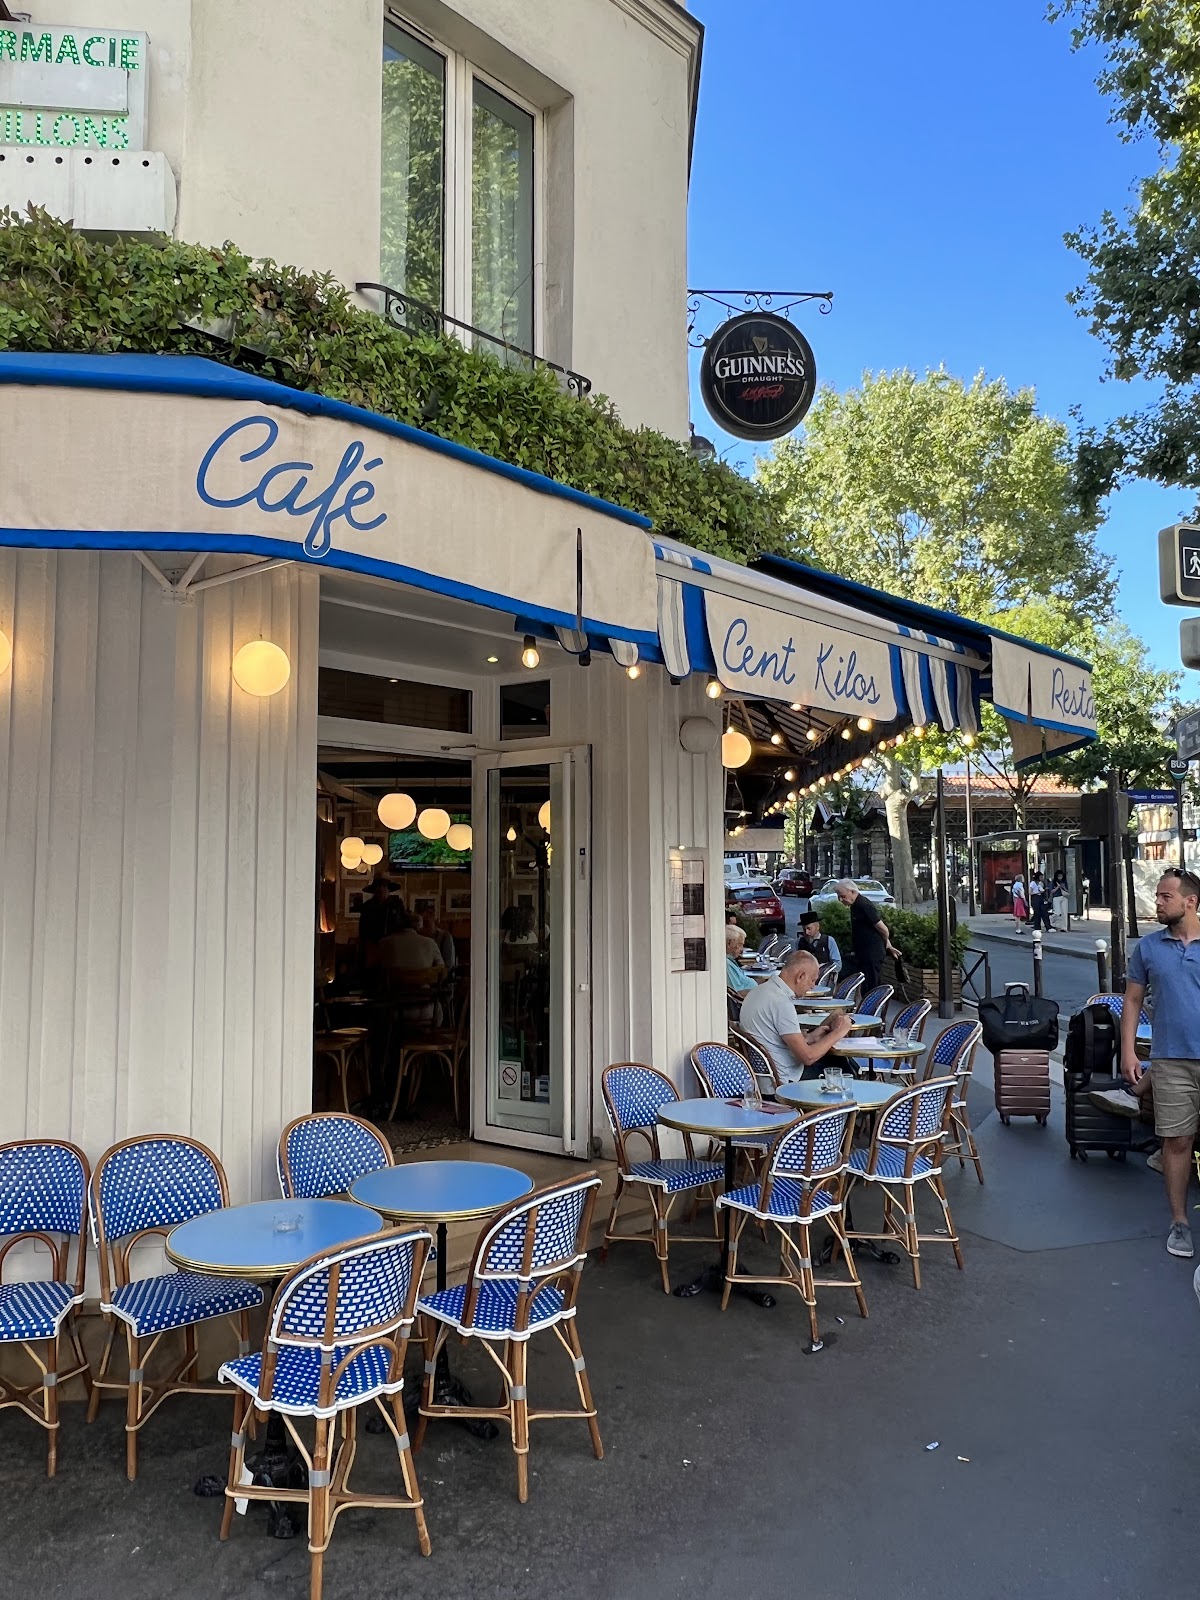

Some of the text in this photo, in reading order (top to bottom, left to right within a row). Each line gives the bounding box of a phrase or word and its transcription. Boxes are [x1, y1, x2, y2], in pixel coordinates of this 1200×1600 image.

[0, 29, 139, 69] RMACIE
[0, 111, 129, 150] ILLONS
[715, 355, 805, 379] GUINNESS
[196, 415, 388, 558] Café
[722, 618, 881, 704] Cent Kilos
[1171, 760, 1186, 769] BUS
